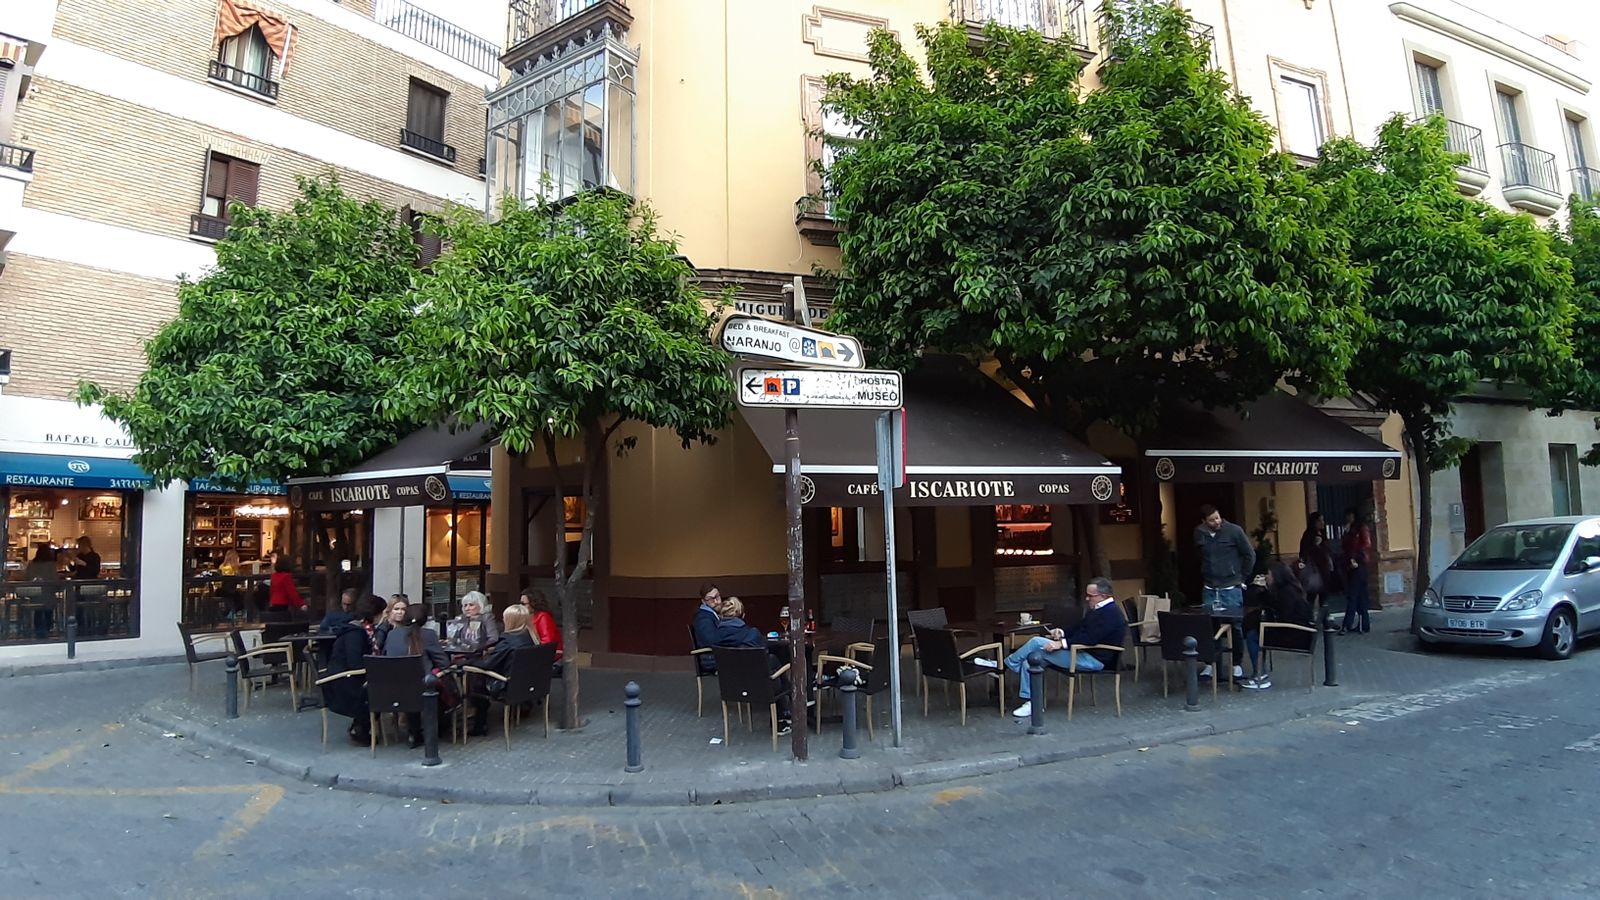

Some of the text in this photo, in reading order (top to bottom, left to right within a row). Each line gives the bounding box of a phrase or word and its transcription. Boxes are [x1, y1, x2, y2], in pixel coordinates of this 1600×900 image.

[807, 307, 829, 319] DE
[753, 325, 790, 339] BREAKFAST
[727, 335, 782, 352] NARANJO
[786, 380, 797, 394] P
[860, 377, 897, 387] HOSTAL
[857, 391, 898, 401] MUSEO
[45, 433, 98, 445] RAFAEL
[1204, 461, 1362, 475] CAFÉ ISCARIOTE COPAS
[6, 475, 75, 487] RESTAURANTE
[331, 484, 390, 503] ISCARIOTE
[396, 486, 420, 496] COPAS
[848, 480, 1070, 498] CAFÉ ISCARIOTE COPAS
